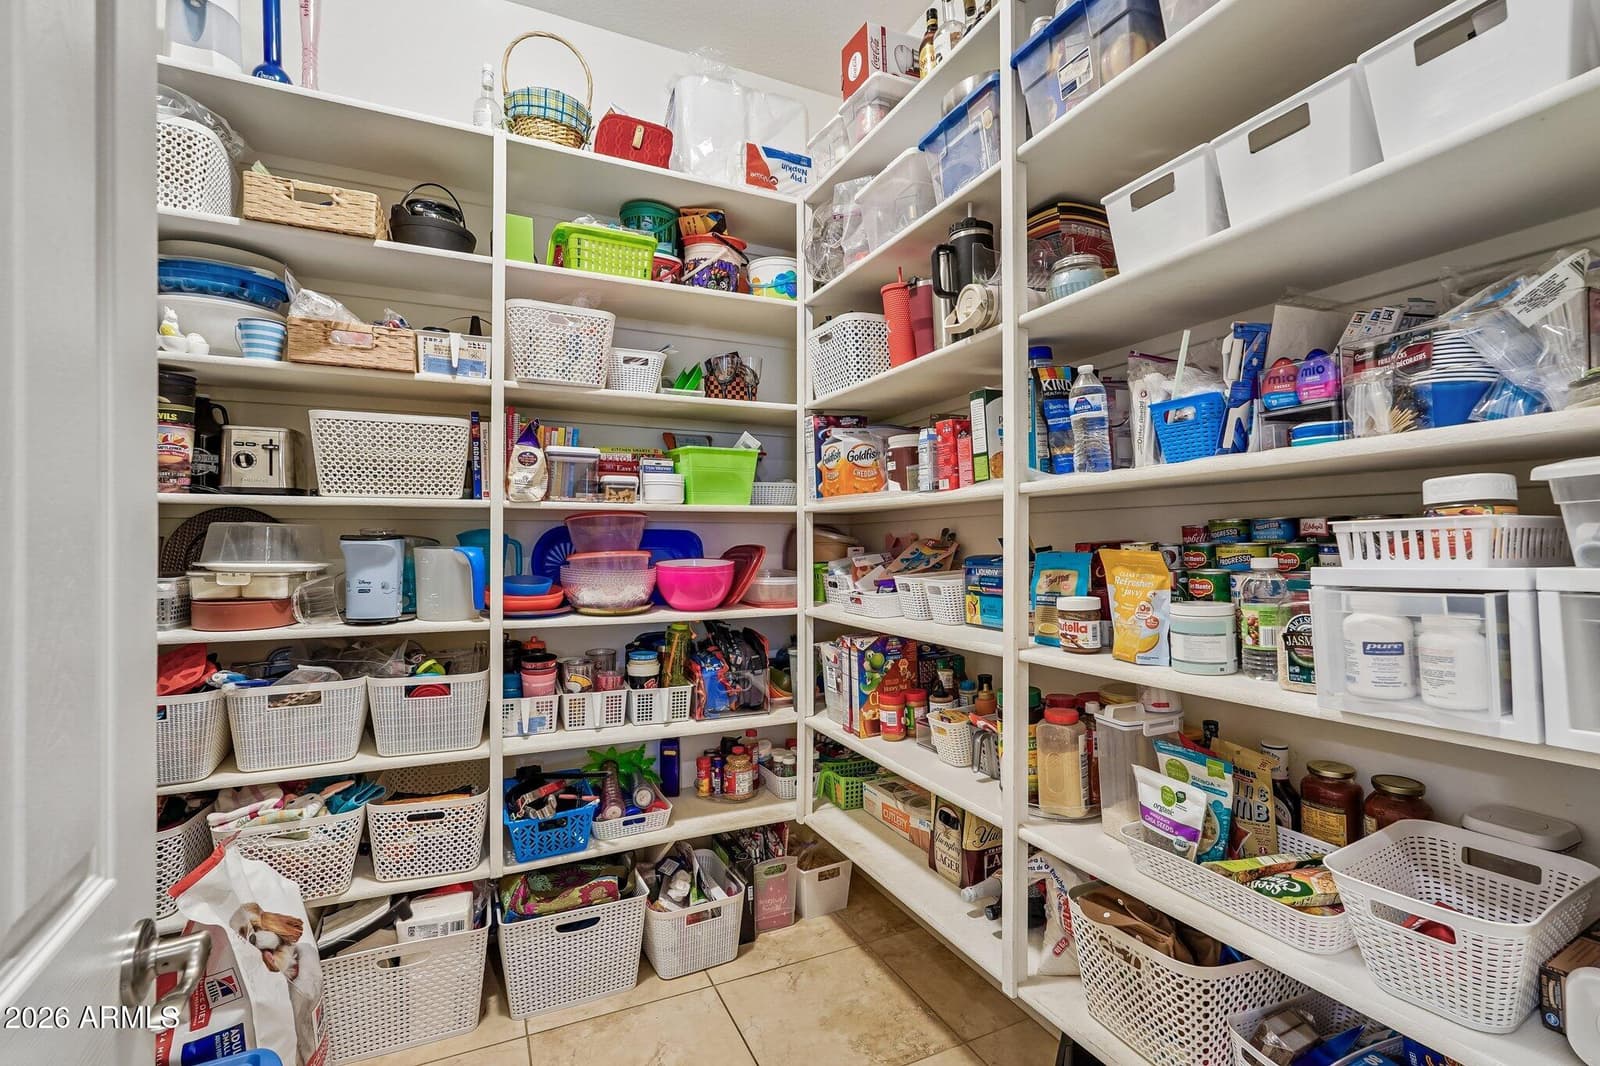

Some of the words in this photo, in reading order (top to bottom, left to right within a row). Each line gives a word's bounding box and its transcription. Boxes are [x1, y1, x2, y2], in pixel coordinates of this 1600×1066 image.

[781, 162, 808, 176] Napkin
[790, 173, 803, 183] Ply
[1301, 364, 1325, 377] mio
[1041, 378, 1073, 392] KIND
[1268, 375, 1296, 384] mio
[847, 447, 881, 463] Goldfish
[1365, 642, 1403, 650] pure
[1153, 802, 1175, 816] organic
[935, 850, 961, 874] LAGER
[206, 979, 220, 1003] Hill's
[197, 1003, 207, 1025] DIET
[222, 1032, 232, 1055] SMALL
